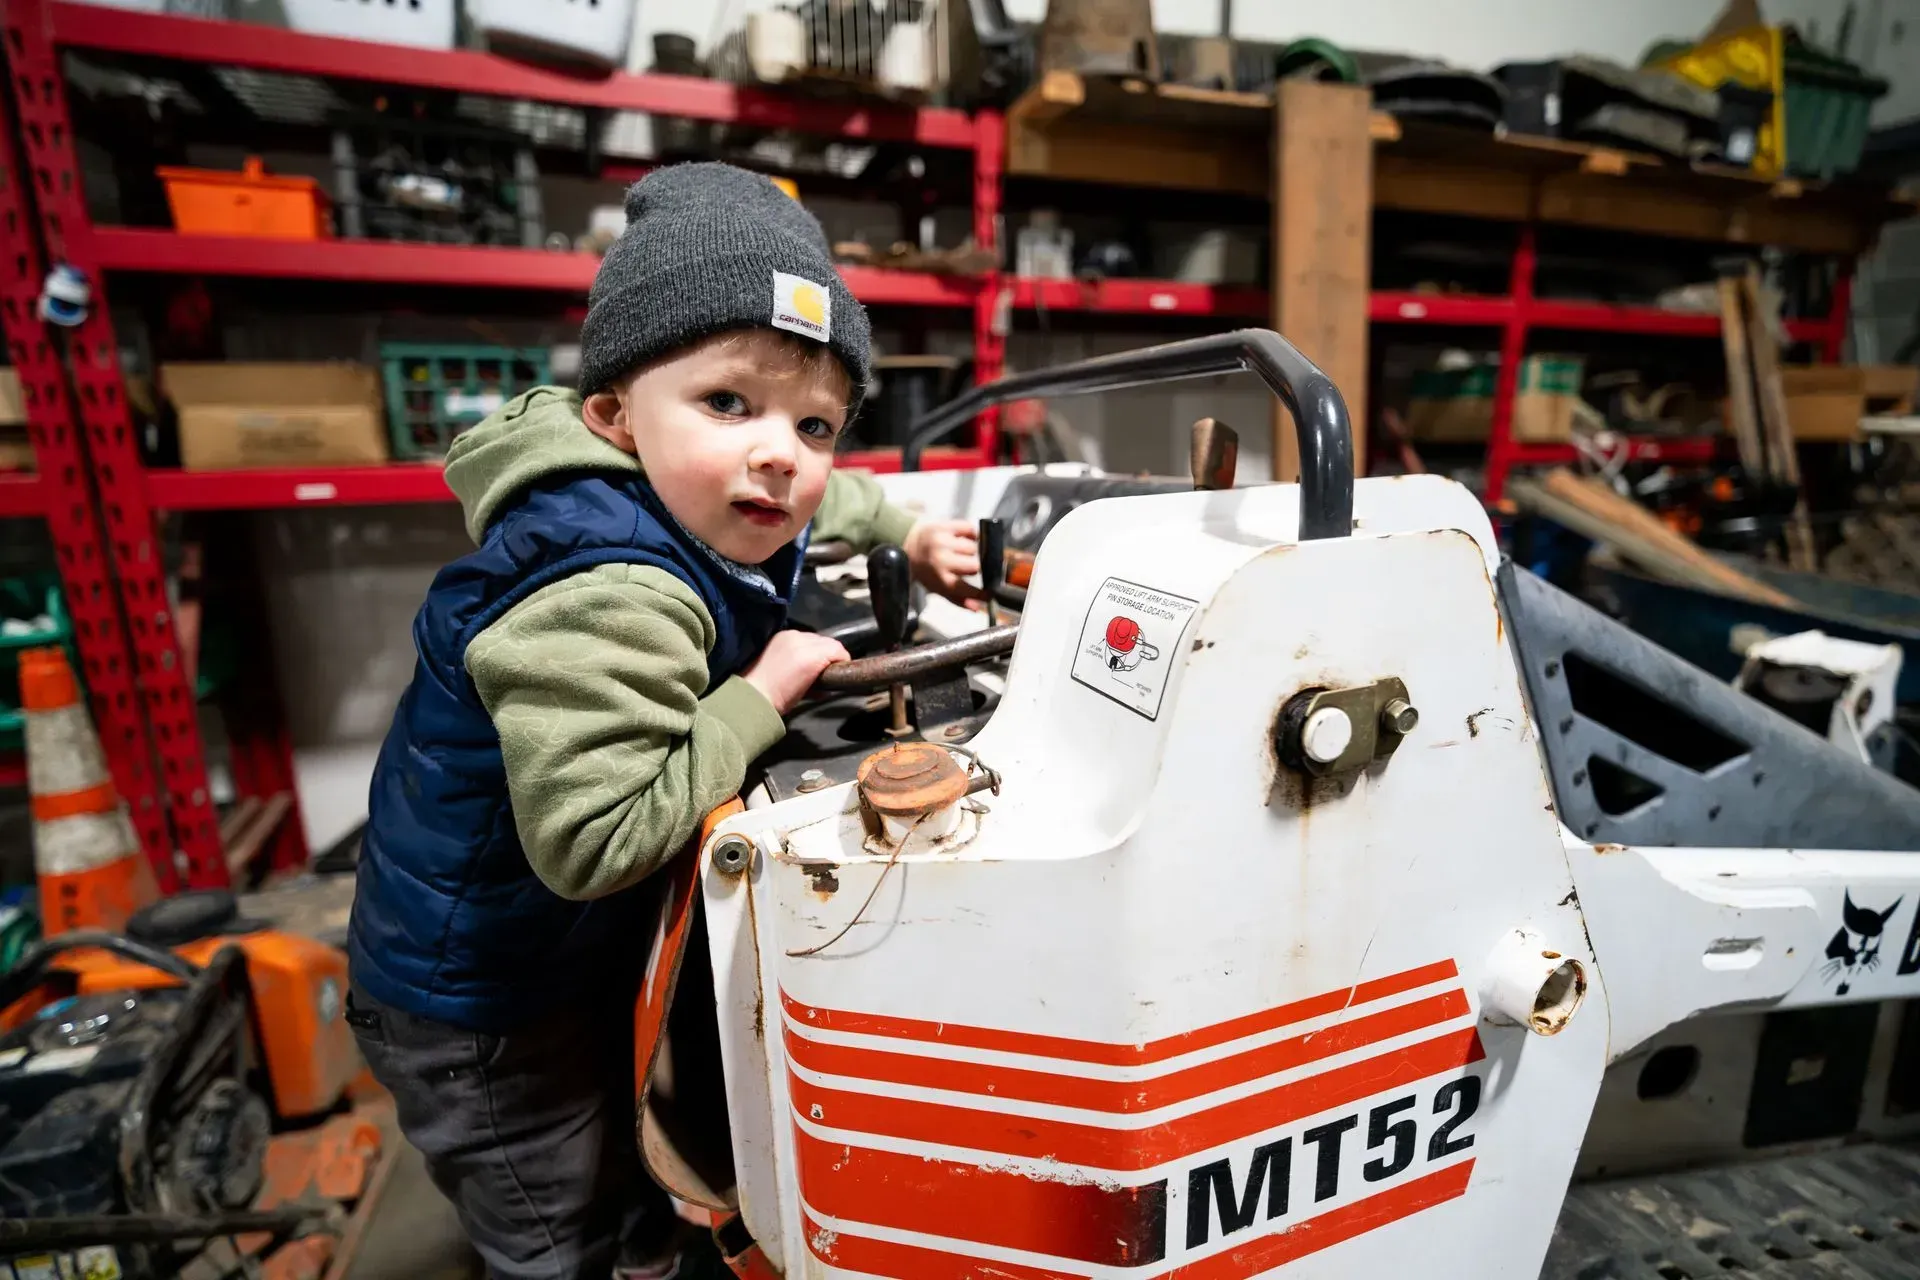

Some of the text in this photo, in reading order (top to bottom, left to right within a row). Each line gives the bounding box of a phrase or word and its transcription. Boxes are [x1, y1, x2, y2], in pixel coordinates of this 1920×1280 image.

[779, 314, 823, 333] carhartt
[1106, 581, 1194, 613] APPROVED LIFT ARM SUPPORT
[1107, 593, 1176, 621] PIN STORAGE LOCATION
[1186, 1075, 1482, 1250] MT52
